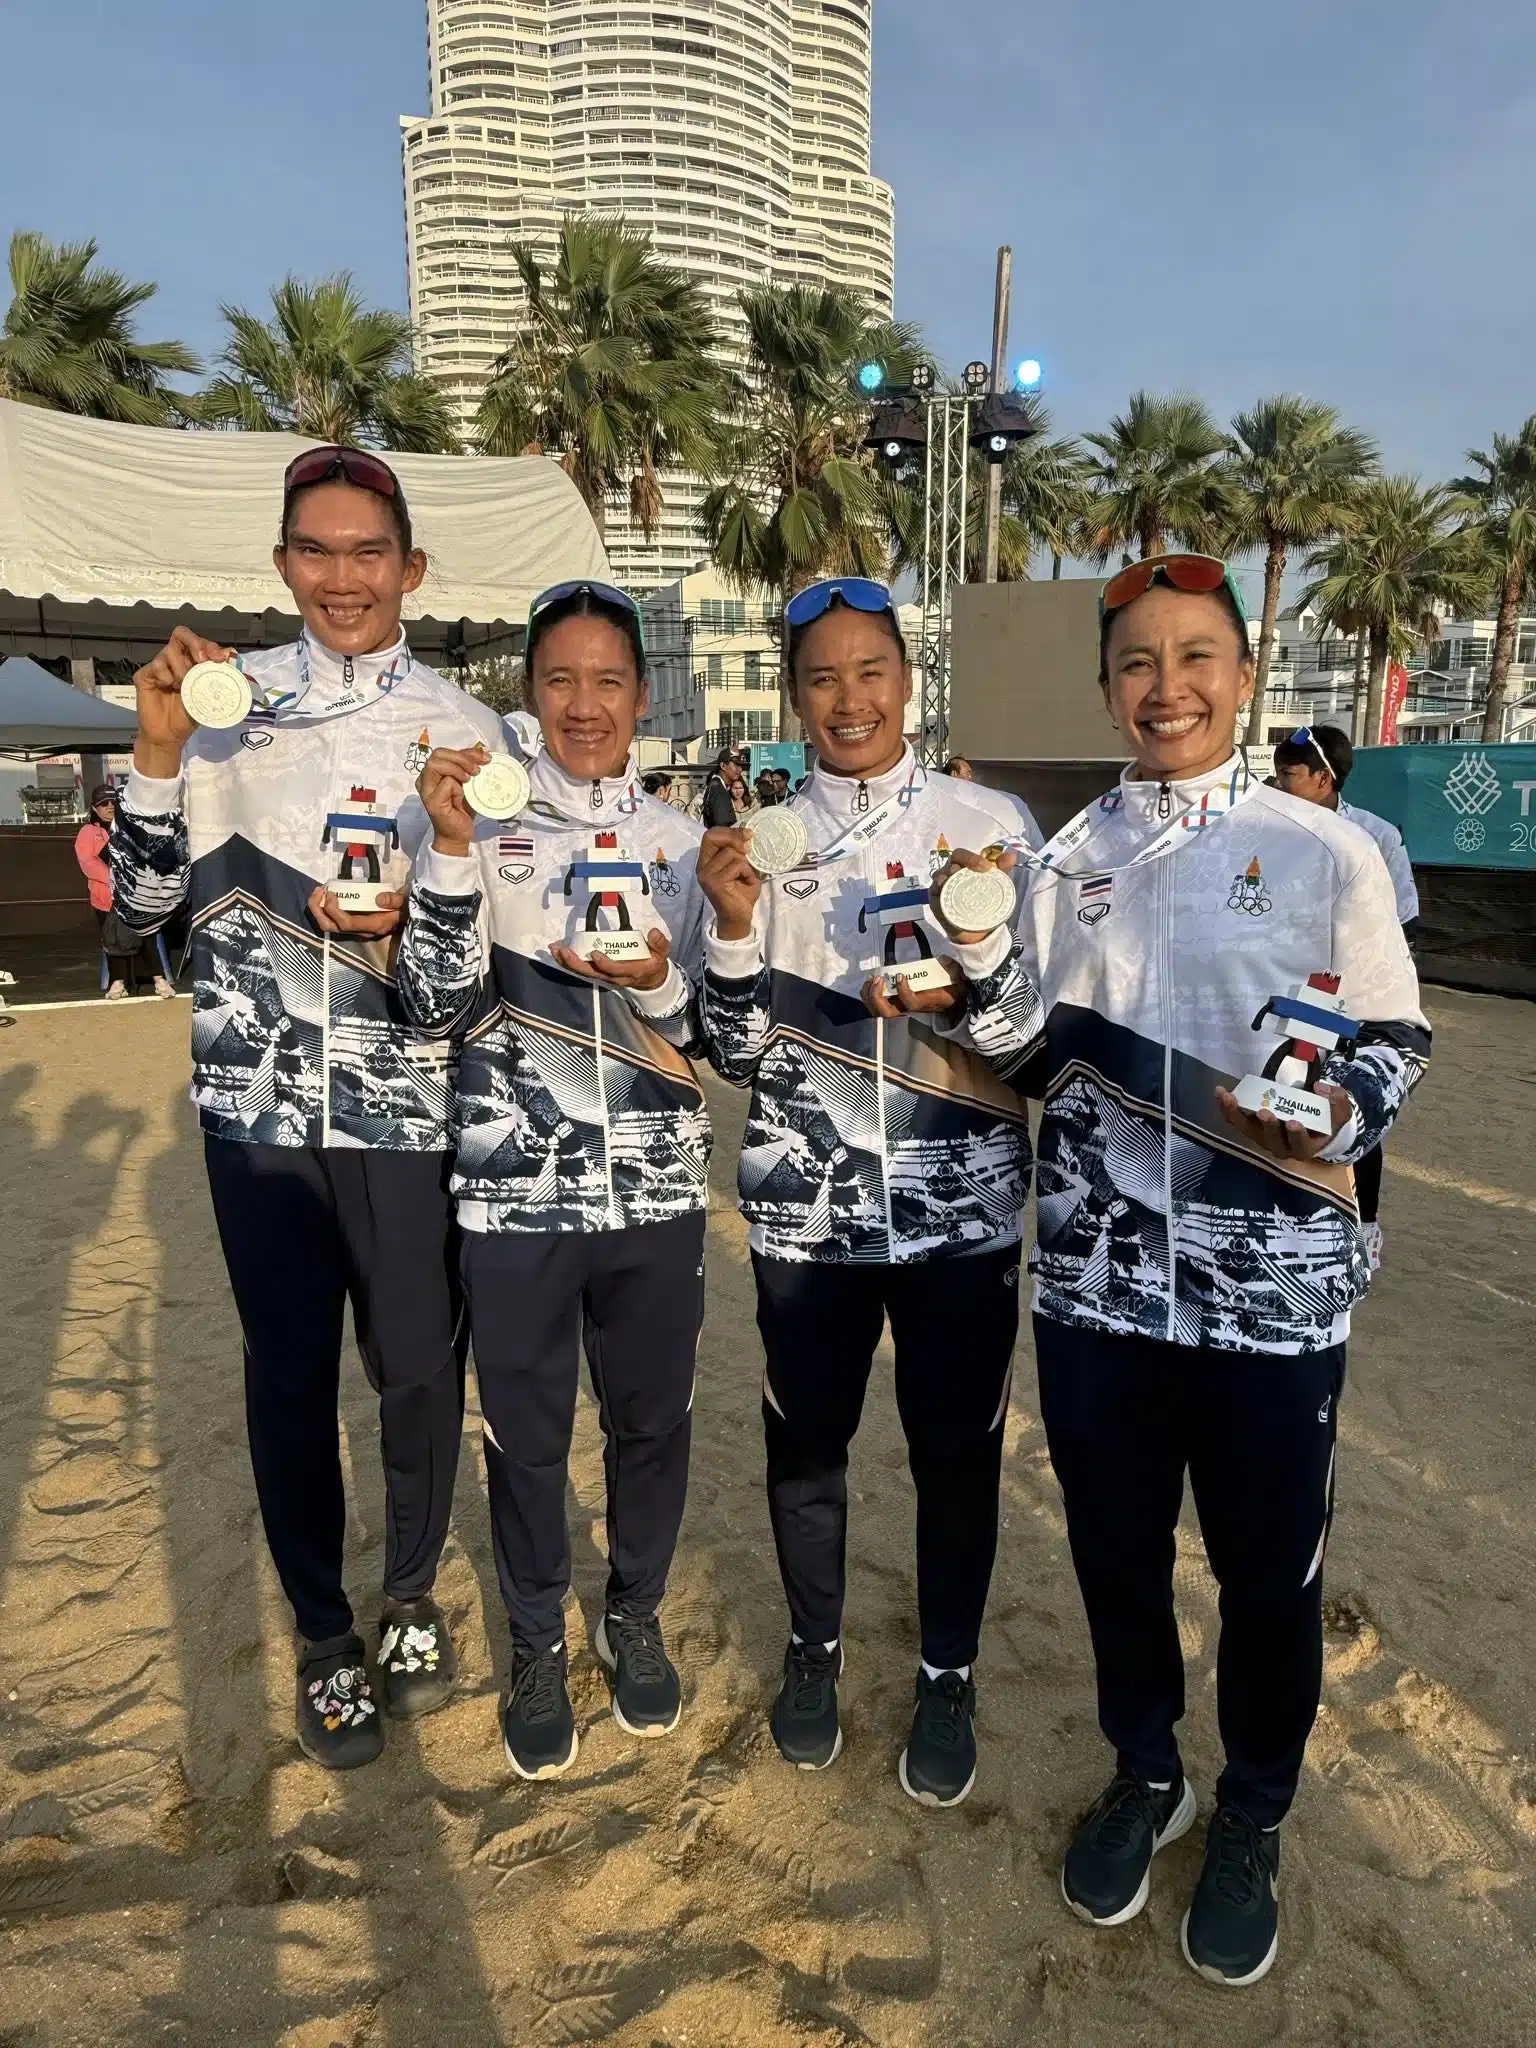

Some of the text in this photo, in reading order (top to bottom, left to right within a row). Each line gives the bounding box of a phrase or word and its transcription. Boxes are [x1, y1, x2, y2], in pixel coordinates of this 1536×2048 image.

[1512, 780, 1536, 816] T
[862, 811, 889, 835] THAILAND
[1063, 816, 1091, 840] THAILAND
[604, 941, 639, 949] THAILAND
[890, 971, 929, 984] TILAND
[1274, 1103, 1295, 1116] 2025
[1277, 1096, 1321, 1117] THAILAND
